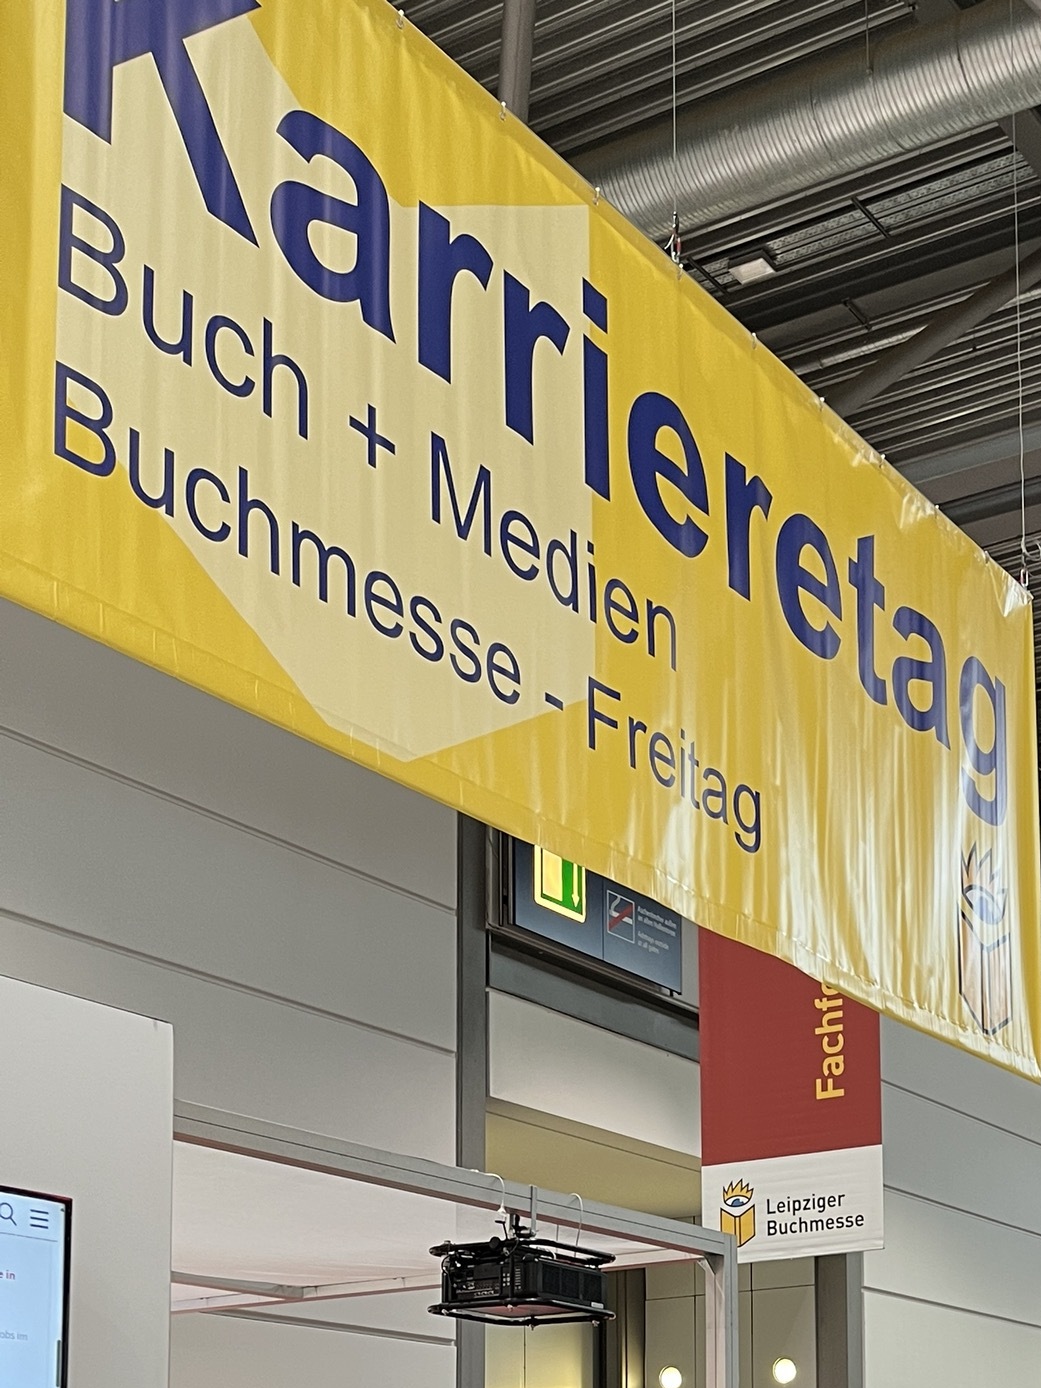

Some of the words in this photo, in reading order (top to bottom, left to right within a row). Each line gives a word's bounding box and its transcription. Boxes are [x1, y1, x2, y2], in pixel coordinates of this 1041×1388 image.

[53, 359, 523, 706] Buchmesse
[585, 685, 763, 854] Freitag
[57, 182, 309, 440] Buch
[347, 403, 397, 470] +
[429, 432, 679, 672] Medien
[63, 0, 1006, 827] Karrieretag
[766, 1193, 846, 1217] Leipziger
[767, 1213, 865, 1237] Buchmesse
